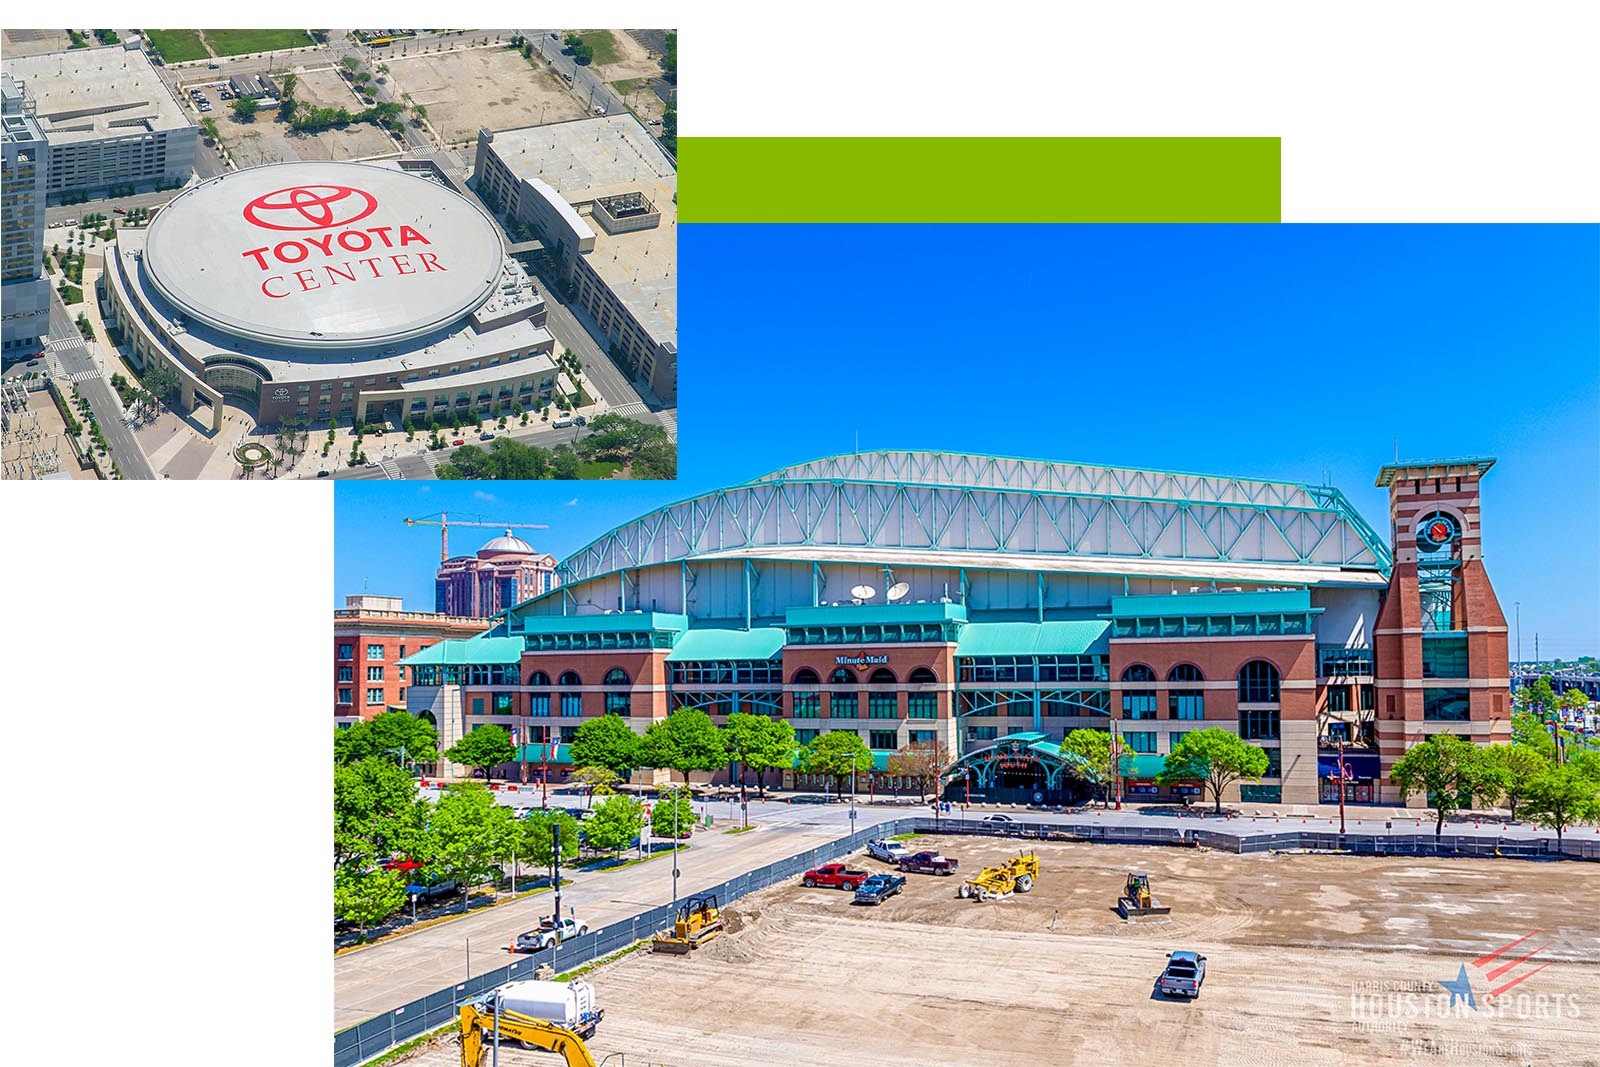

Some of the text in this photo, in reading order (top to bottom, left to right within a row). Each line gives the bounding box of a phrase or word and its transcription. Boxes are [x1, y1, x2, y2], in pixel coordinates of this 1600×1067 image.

[242, 225, 431, 271] TOYOTA
[261, 252, 448, 299] CENTER
[835, 655, 888, 664] Minute Maid
